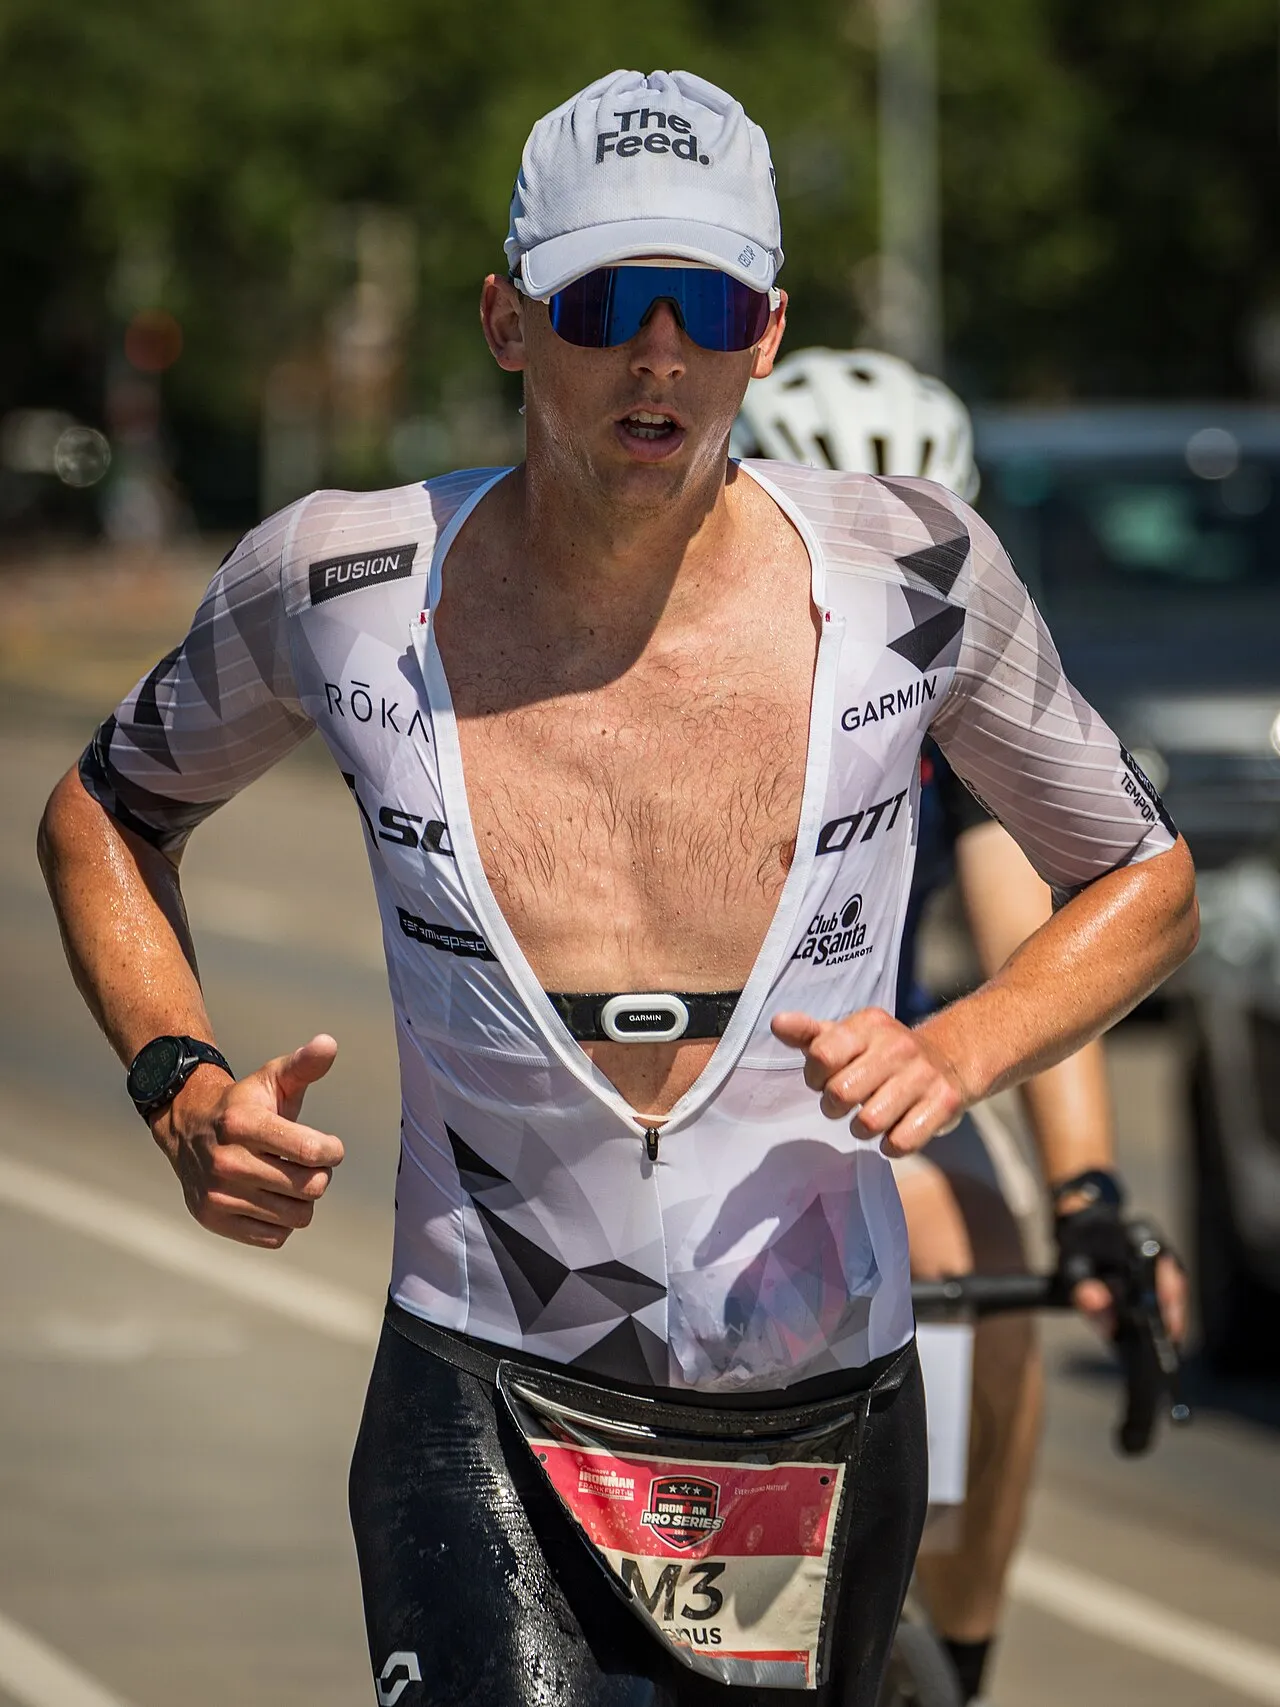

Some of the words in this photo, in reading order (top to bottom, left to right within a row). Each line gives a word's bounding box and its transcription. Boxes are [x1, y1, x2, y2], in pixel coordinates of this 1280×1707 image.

[613, 108, 692, 134] The
[596, 131, 710, 166] Feed.
[324, 554, 400, 587] FUSION
[807, 912, 838, 935] Club
[629, 1014, 661, 1022] GARMIN
[578, 1481, 625, 1496] FRANKFURT
[579, 1470, 635, 1489] IRONMAN
[643, 1512, 671, 1526] PRO
[672, 1514, 722, 1530] SERIES
[621, 1557, 726, 1621] M3
